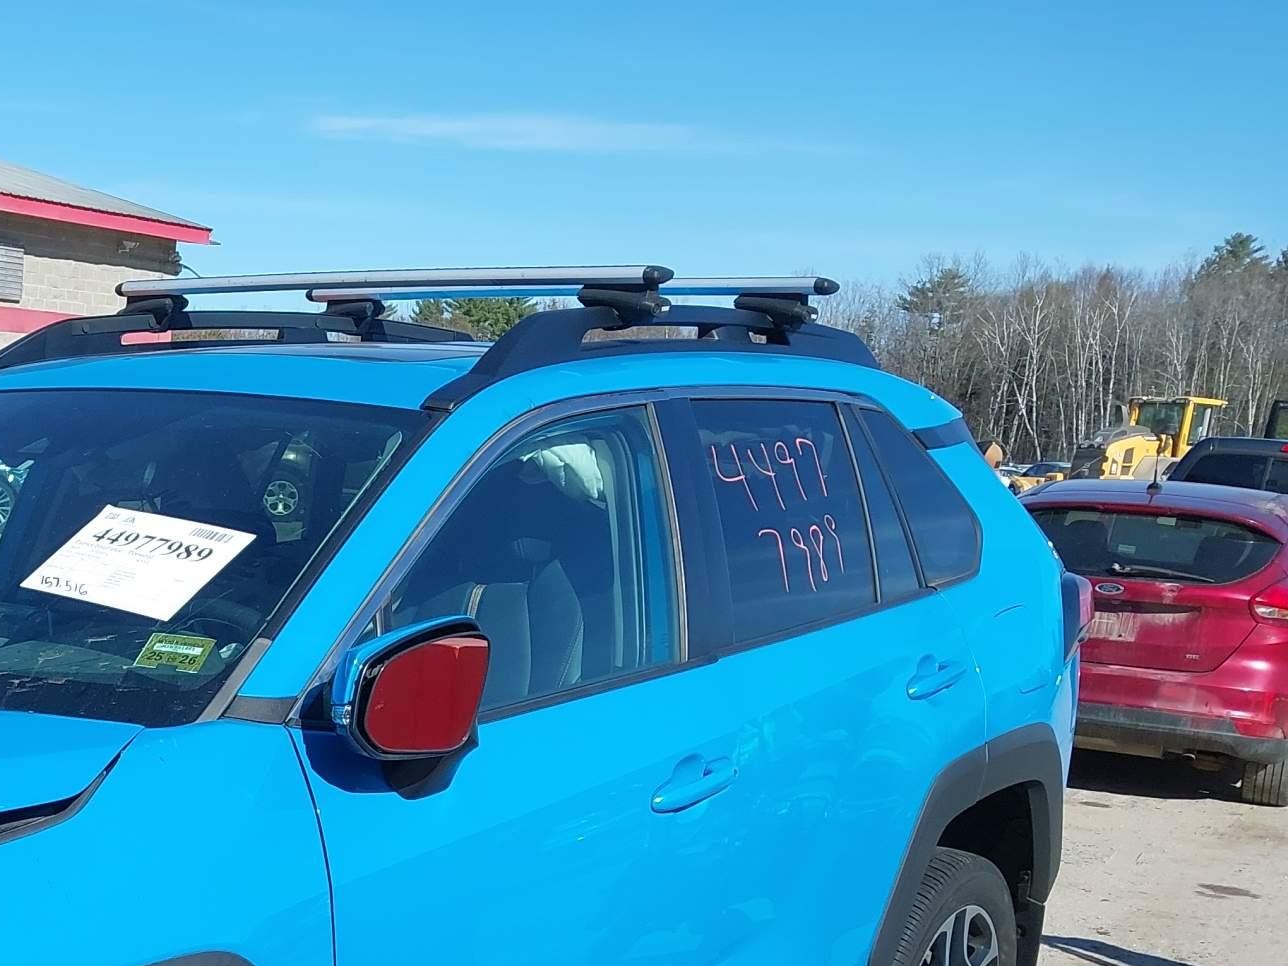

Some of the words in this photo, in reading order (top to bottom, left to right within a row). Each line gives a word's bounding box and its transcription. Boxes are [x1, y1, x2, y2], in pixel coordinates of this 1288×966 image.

[711, 438, 828, 512] 4497
[92, 527, 214, 562] 44977989
[758, 514, 845, 593] 7989
[145, 651, 165, 661] 25
[178, 655, 198, 665] 26
